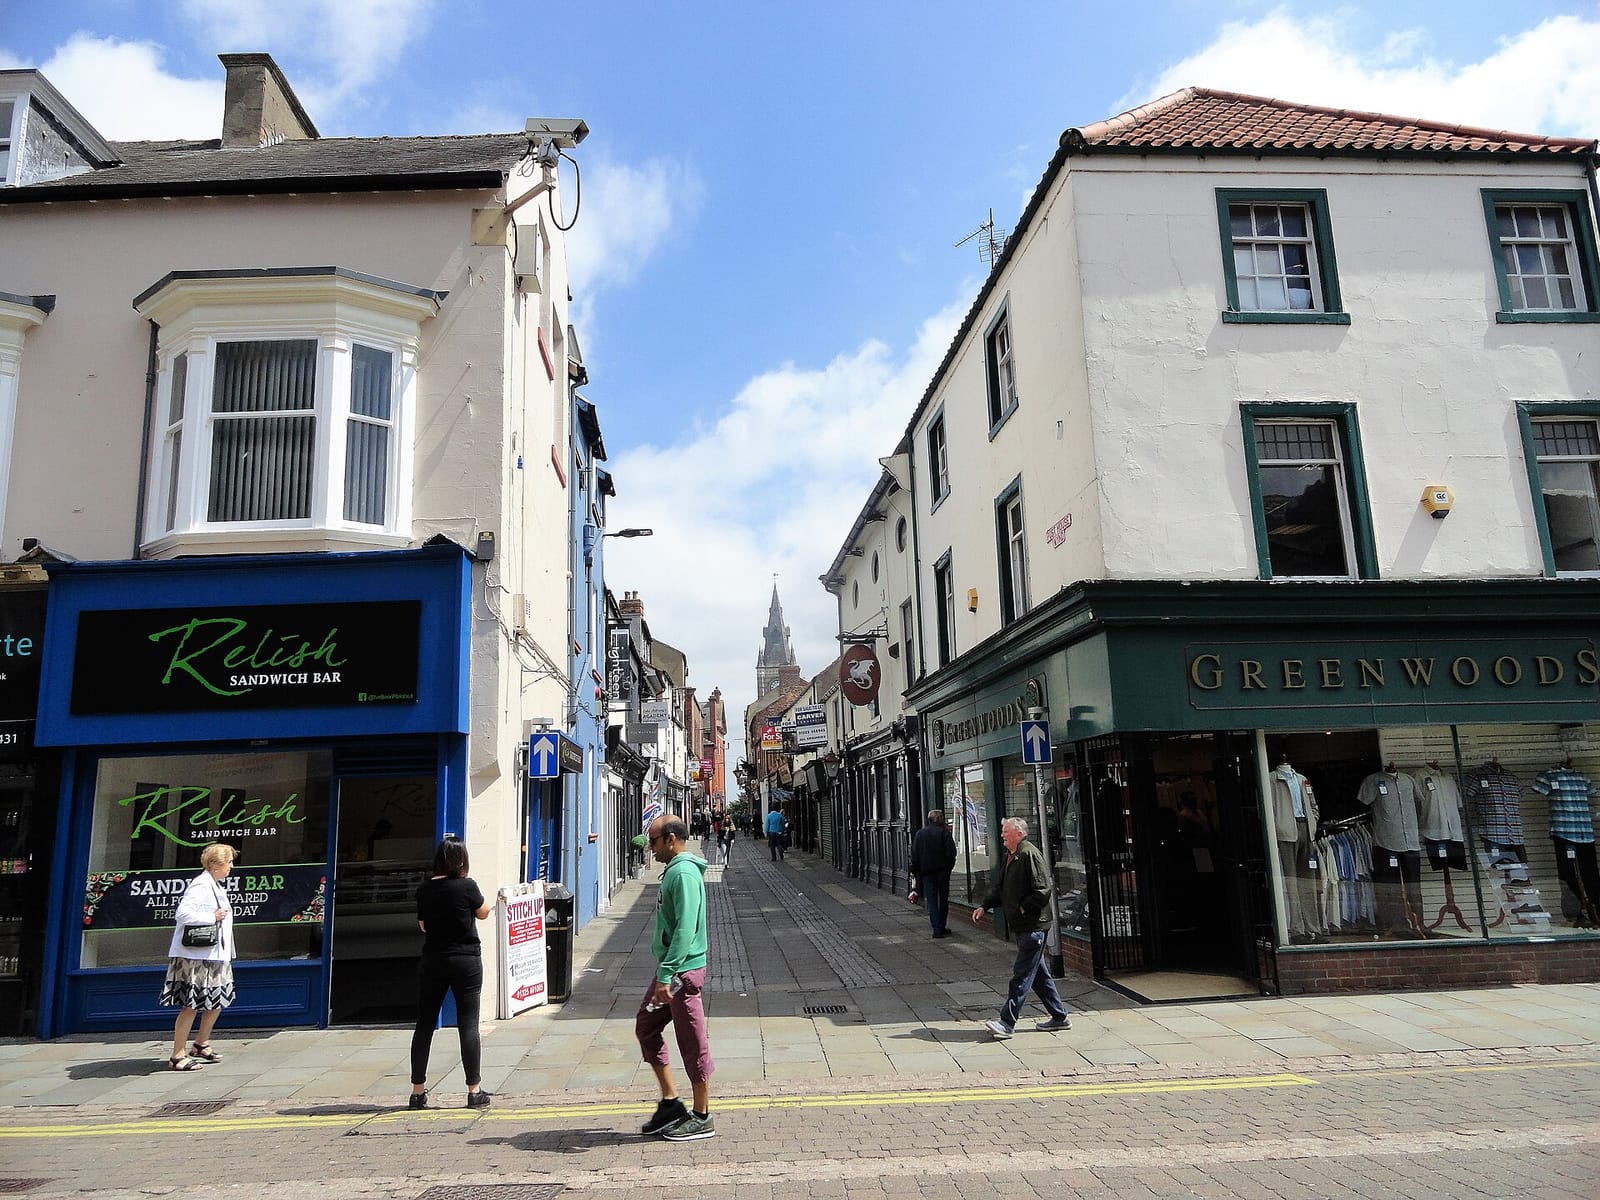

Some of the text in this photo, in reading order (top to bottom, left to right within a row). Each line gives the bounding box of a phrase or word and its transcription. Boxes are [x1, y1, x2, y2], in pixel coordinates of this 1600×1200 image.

[0, 634, 33, 657] te
[149, 618, 347, 696] Relish
[608, 626, 630, 699] Eighteen
[230, 672, 342, 687] SANDWICH BAR
[1190, 649, 1600, 690] GREENWOODS
[797, 712, 825, 720] CARVER
[945, 697, 1023, 744] GREENWOODS
[763, 733, 775, 741] For
[118, 787, 307, 847] Relish
[191, 827, 277, 839] SANDWICH BAR
[131, 875, 284, 896] SANDCH BAR
[145, 896, 169, 907] ALL
[228, 893, 268, 904] PARED
[154, 909, 175, 919] FRE
[507, 897, 543, 922] STITCH UP
